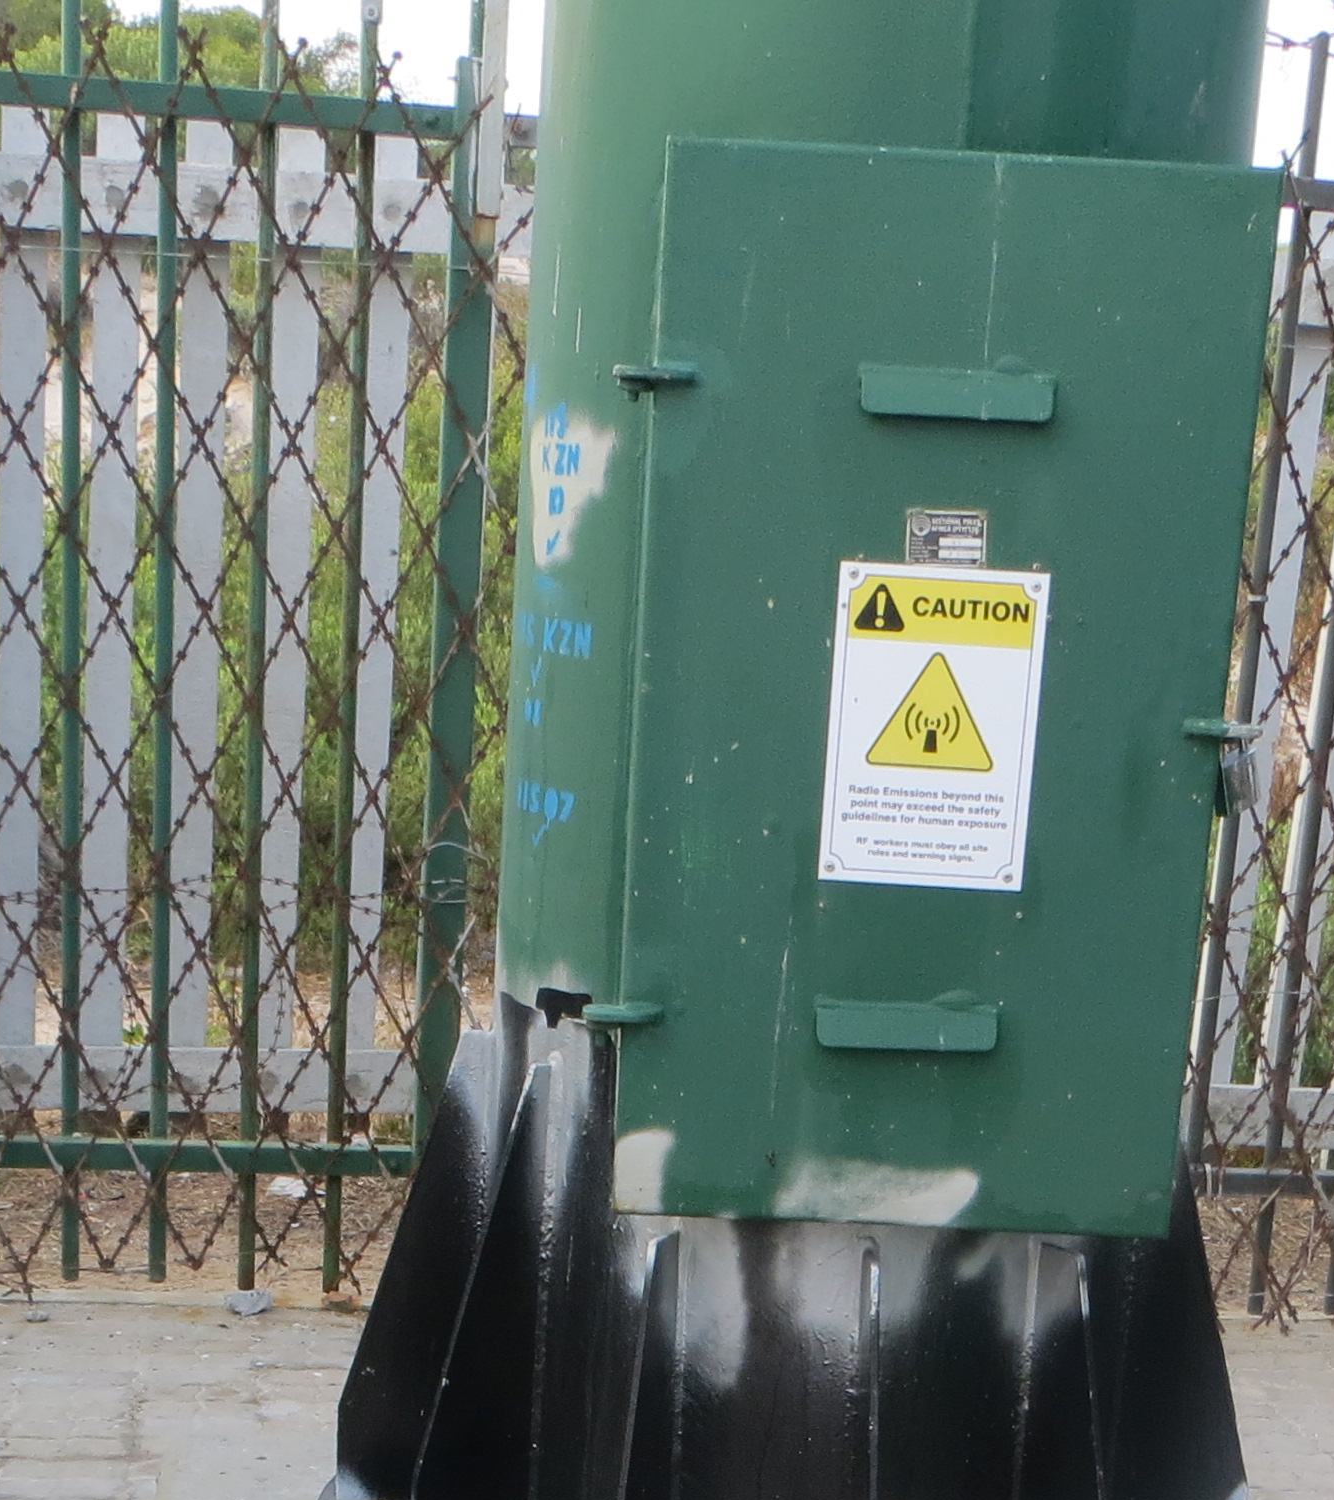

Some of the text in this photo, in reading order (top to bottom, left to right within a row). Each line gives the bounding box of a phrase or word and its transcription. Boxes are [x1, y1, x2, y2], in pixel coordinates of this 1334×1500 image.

[542, 443, 581, 476] KZN
[912, 596, 1030, 623] CAUTION
[543, 617, 593, 658] KZN
[848, 784, 1005, 804] Radio Emissions beyond this
[850, 799, 1001, 818] point may exceed the safety
[841, 811, 1008, 830] guidelines for human exposure
[856, 836, 989, 852] RF workers must obey all site
[867, 848, 975, 863] rules and warning signs.
